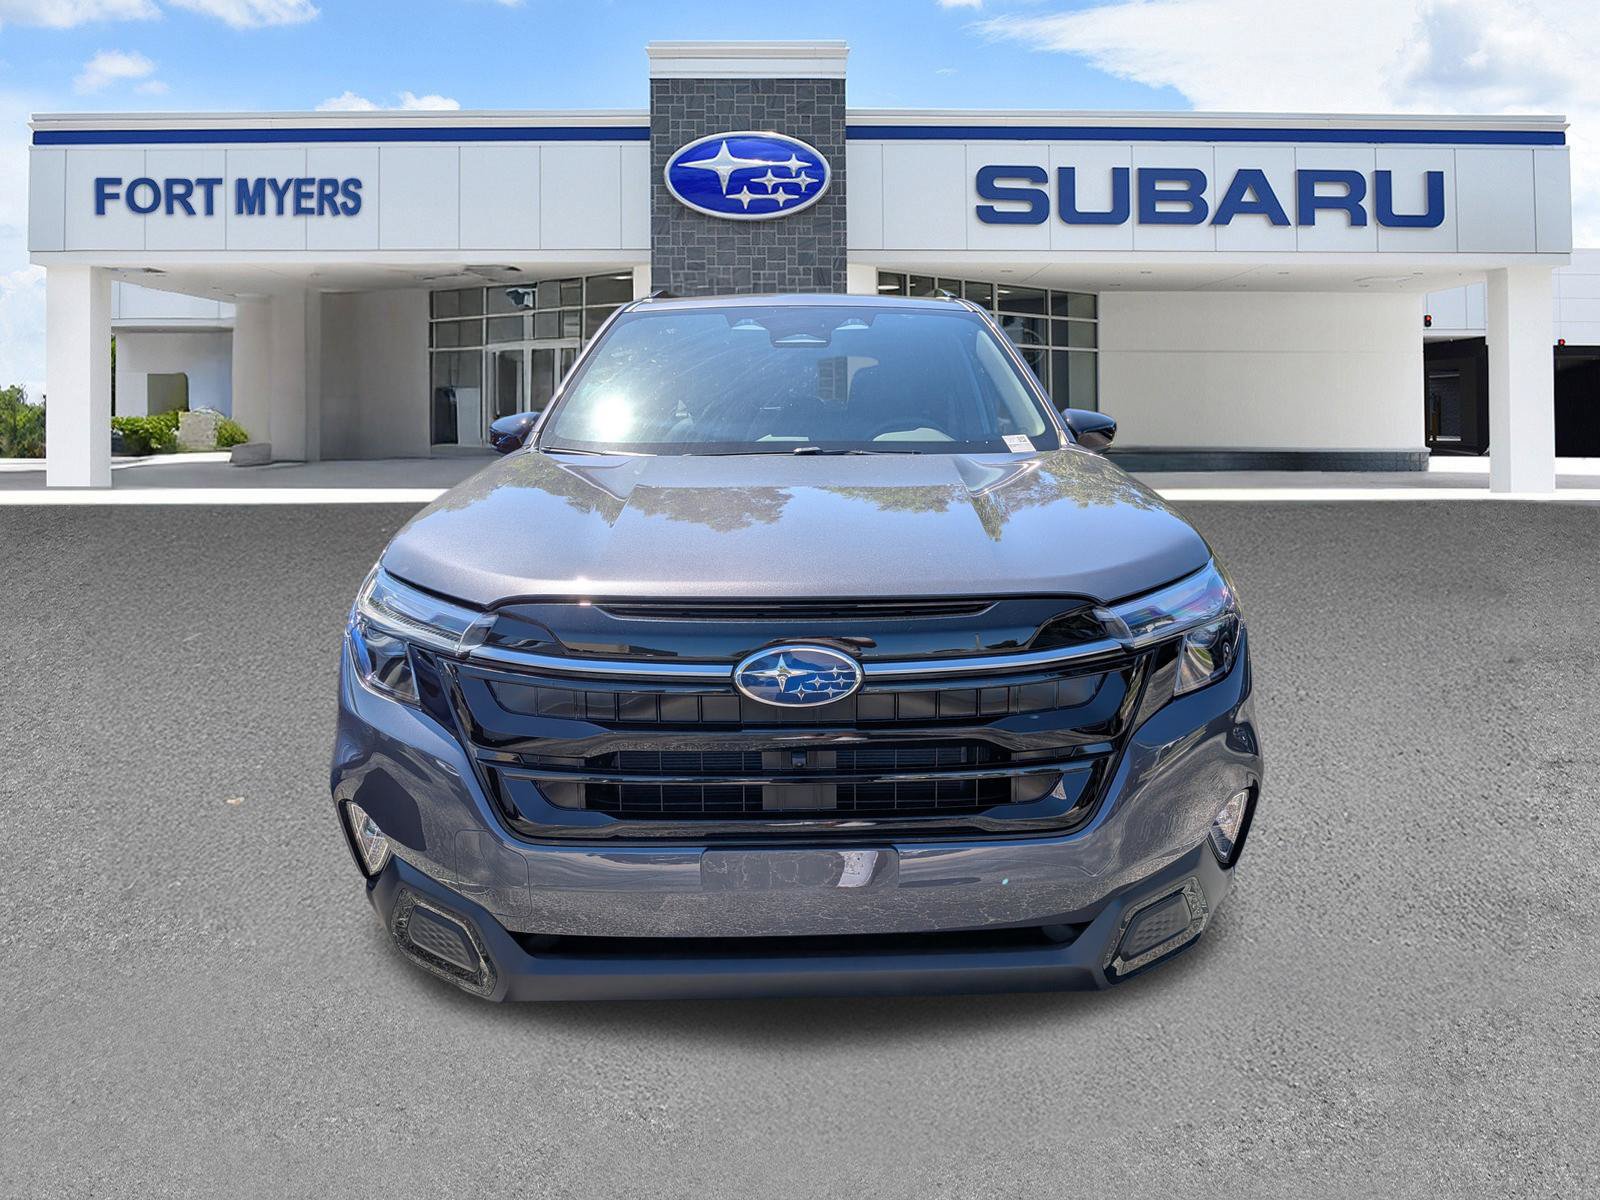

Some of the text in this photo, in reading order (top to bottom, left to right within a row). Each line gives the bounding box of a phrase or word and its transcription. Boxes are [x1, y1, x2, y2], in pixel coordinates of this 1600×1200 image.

[95, 177, 363, 216] FORT MYERS
[975, 164, 1446, 228] SUBARU
